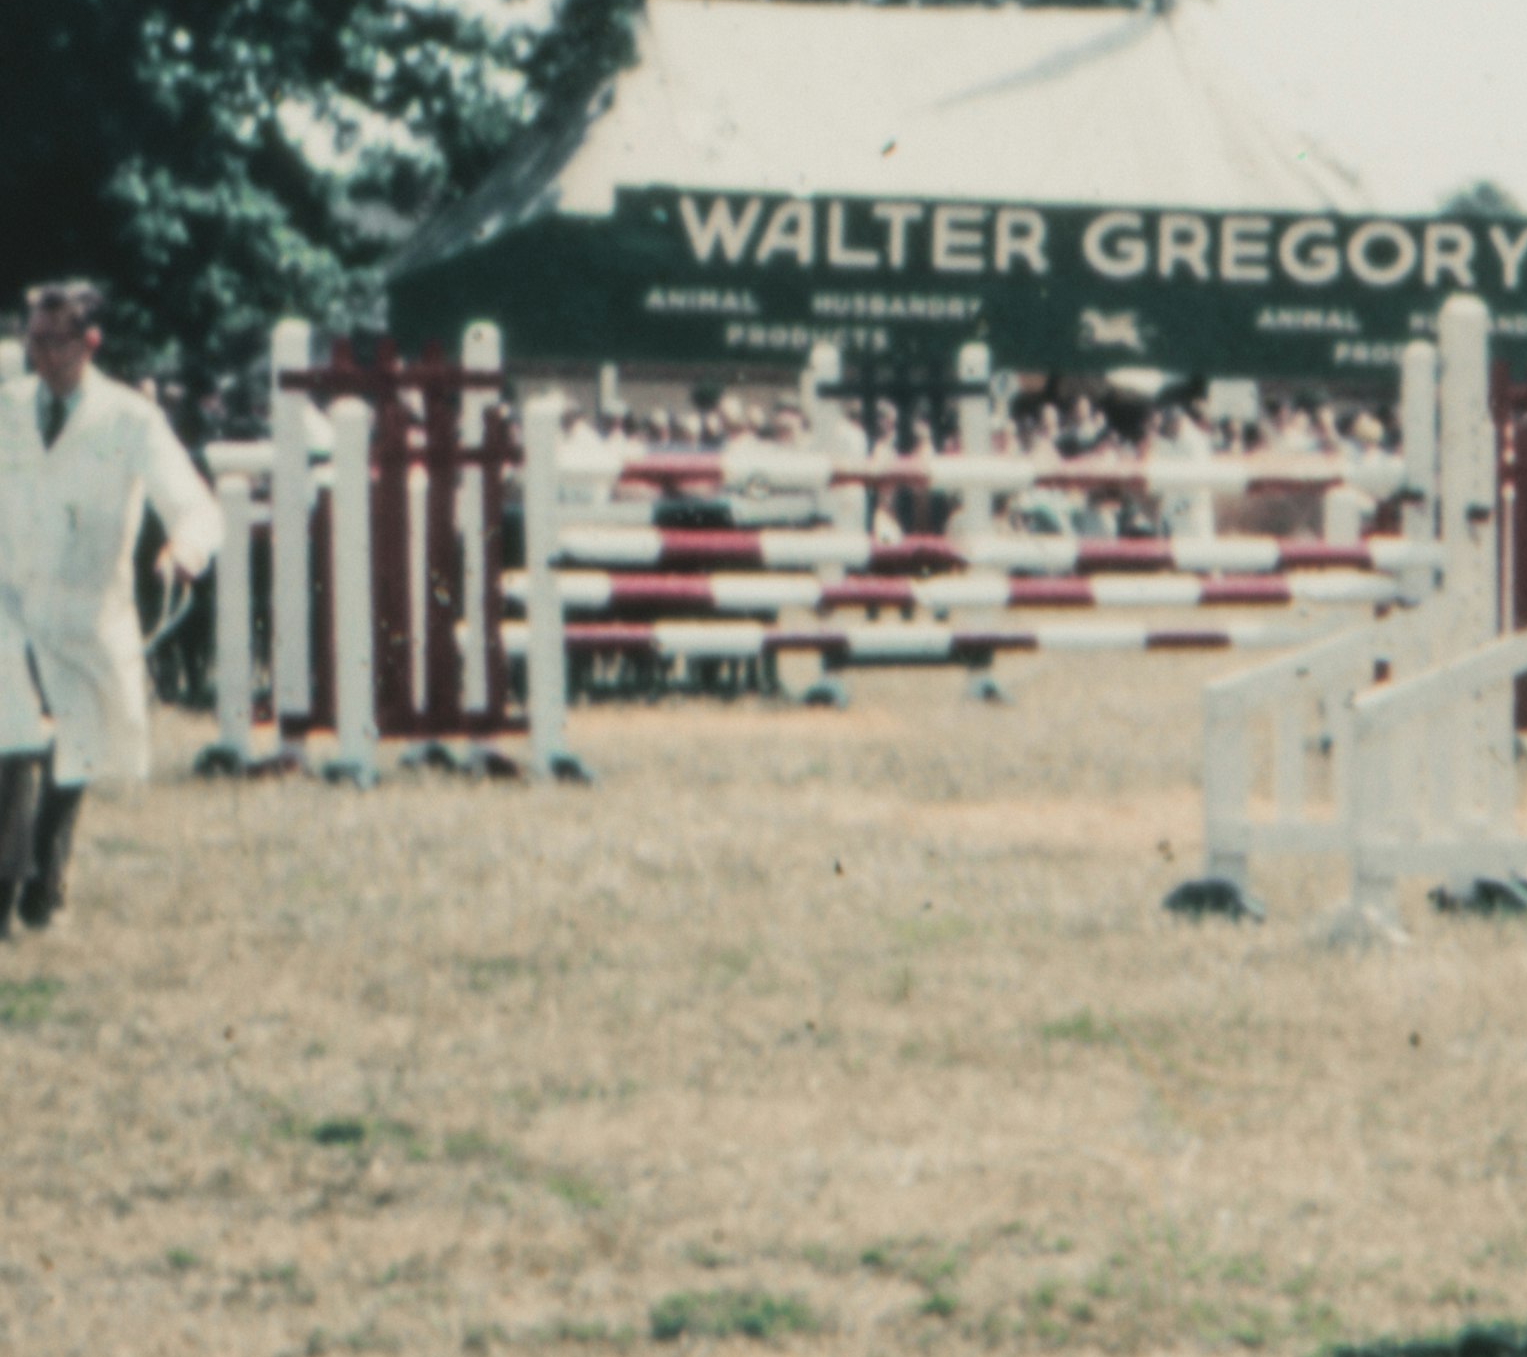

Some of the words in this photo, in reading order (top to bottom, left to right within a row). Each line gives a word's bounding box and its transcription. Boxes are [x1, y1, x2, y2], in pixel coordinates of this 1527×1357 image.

[678, 195, 1050, 274] WALTER
[646, 288, 757, 314] ANIMAL
[811, 293, 983, 319] HUSBANDRY
[1256, 306, 1359, 333] ANIMAL
